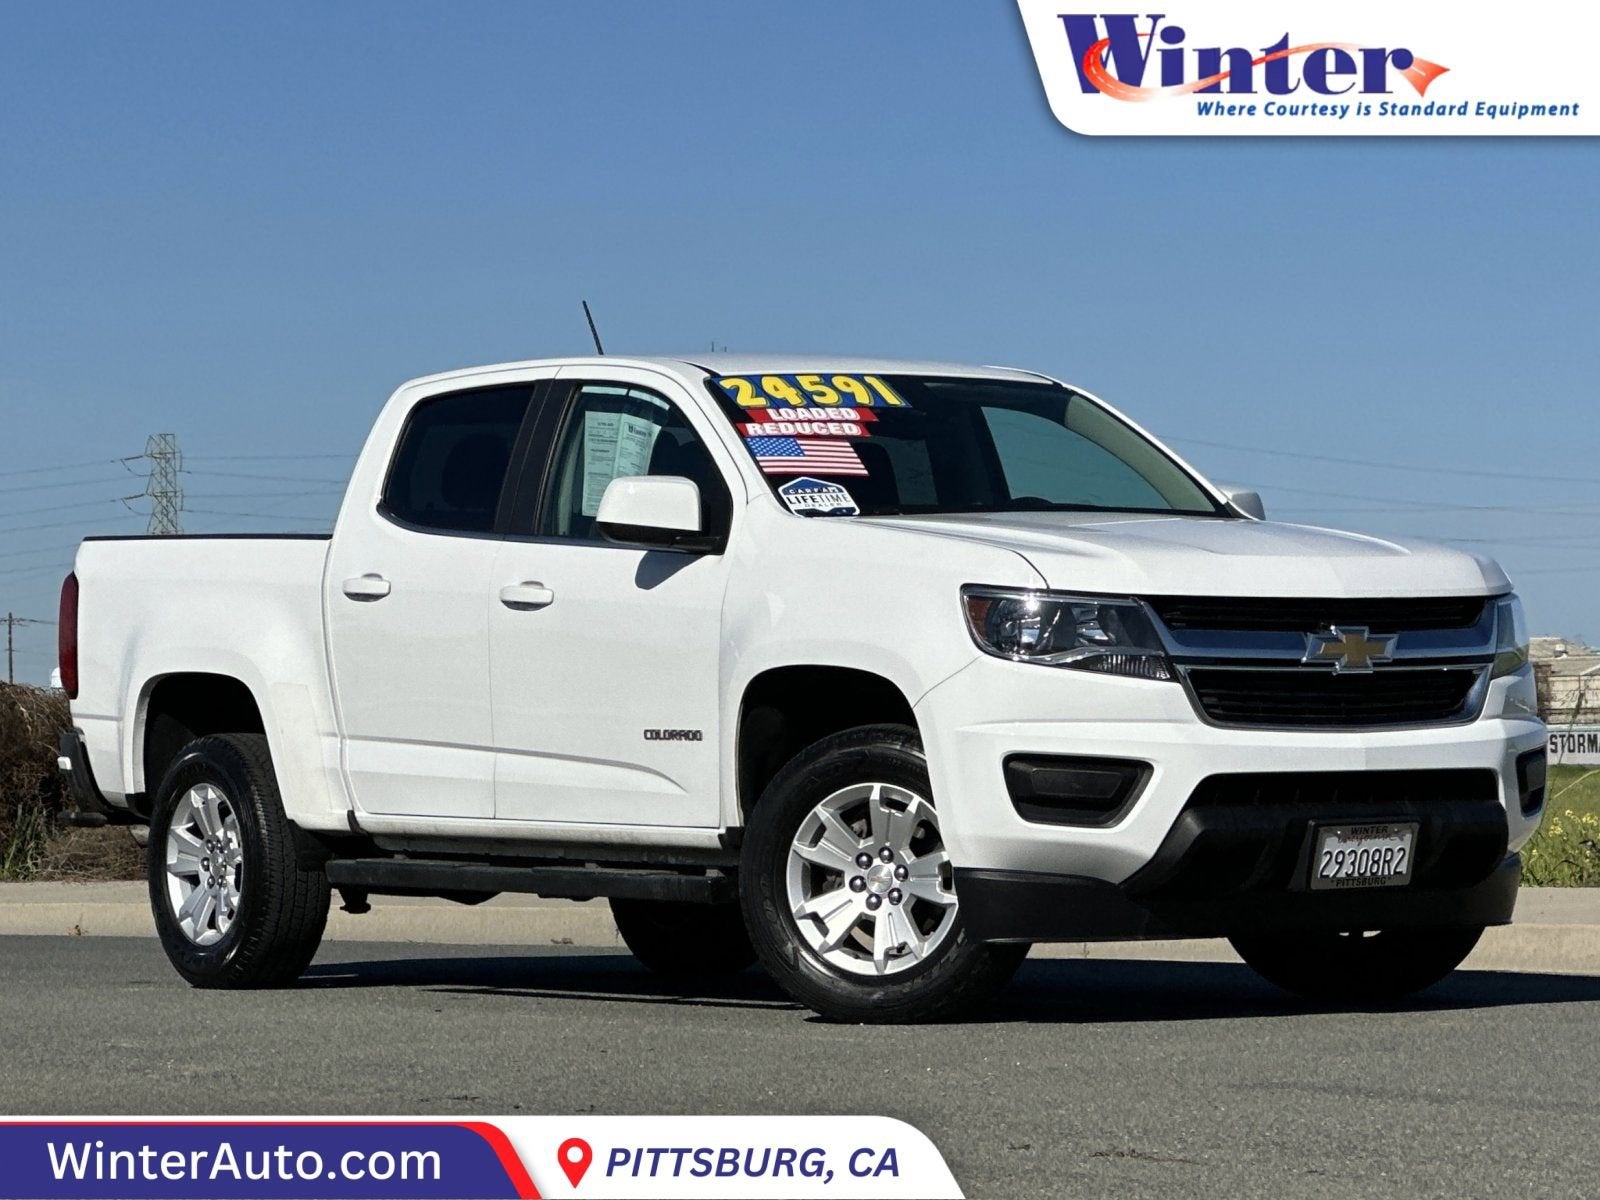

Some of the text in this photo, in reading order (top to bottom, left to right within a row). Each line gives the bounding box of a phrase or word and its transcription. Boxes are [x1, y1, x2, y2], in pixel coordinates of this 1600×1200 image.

[719, 375, 903, 407] 24591
[766, 407, 860, 421] LOADED
[745, 422, 862, 437] REDUCED
[786, 494, 851, 505] LIFETIME
[643, 729, 703, 741] COLORADO
[1549, 733, 1600, 754] STORM
[1351, 826, 1388, 835] WINTER
[1319, 847, 1406, 878] 29308R2
